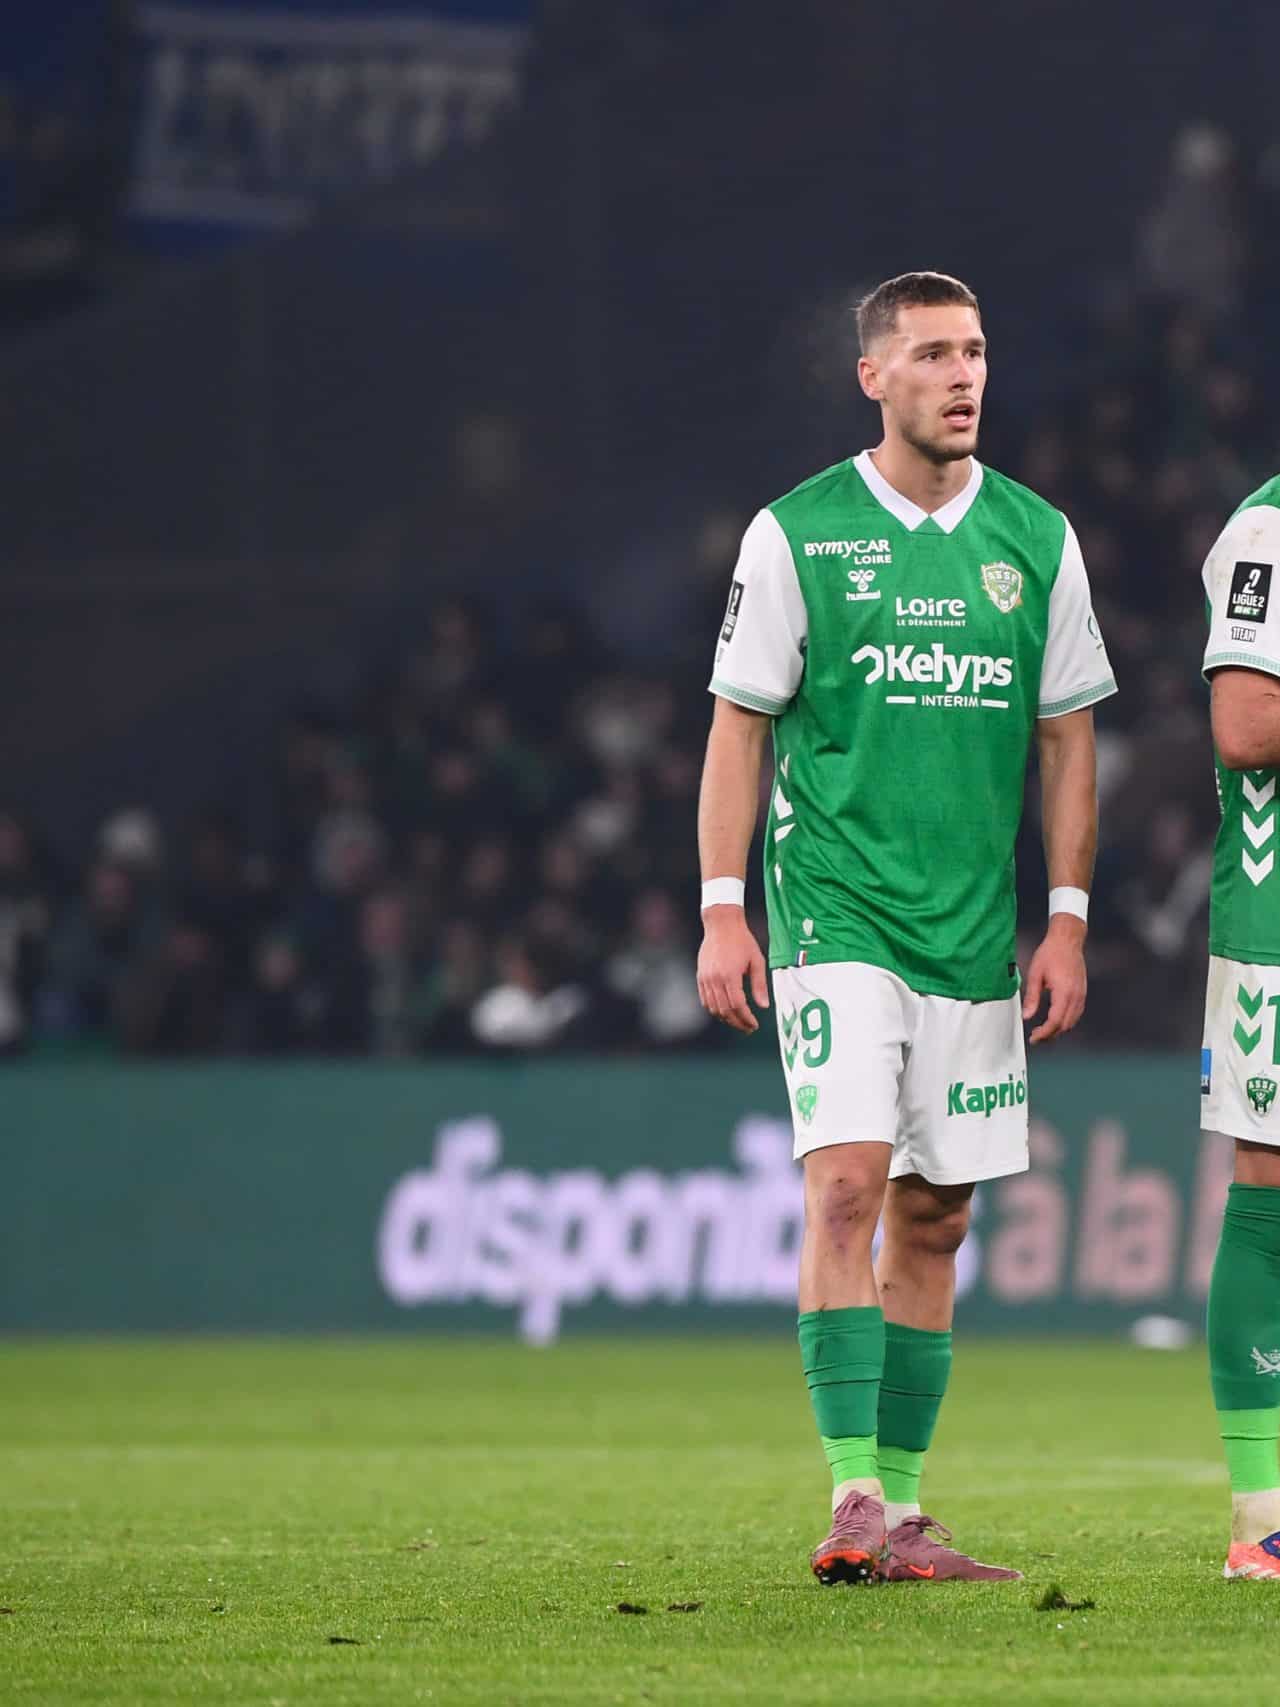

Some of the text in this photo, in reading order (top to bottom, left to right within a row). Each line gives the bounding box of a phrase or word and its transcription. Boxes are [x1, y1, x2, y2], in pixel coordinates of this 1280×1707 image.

[854, 554, 893, 565] LOIRE
[1242, 568, 1262, 594] 2
[896, 596, 967, 617] Loire
[896, 619, 906, 627] LE
[887, 643, 1013, 693] Kelyps
[922, 694, 979, 708] INTERIM
[800, 998, 832, 1069] 9
[947, 1070, 1027, 1118] Kaprio
